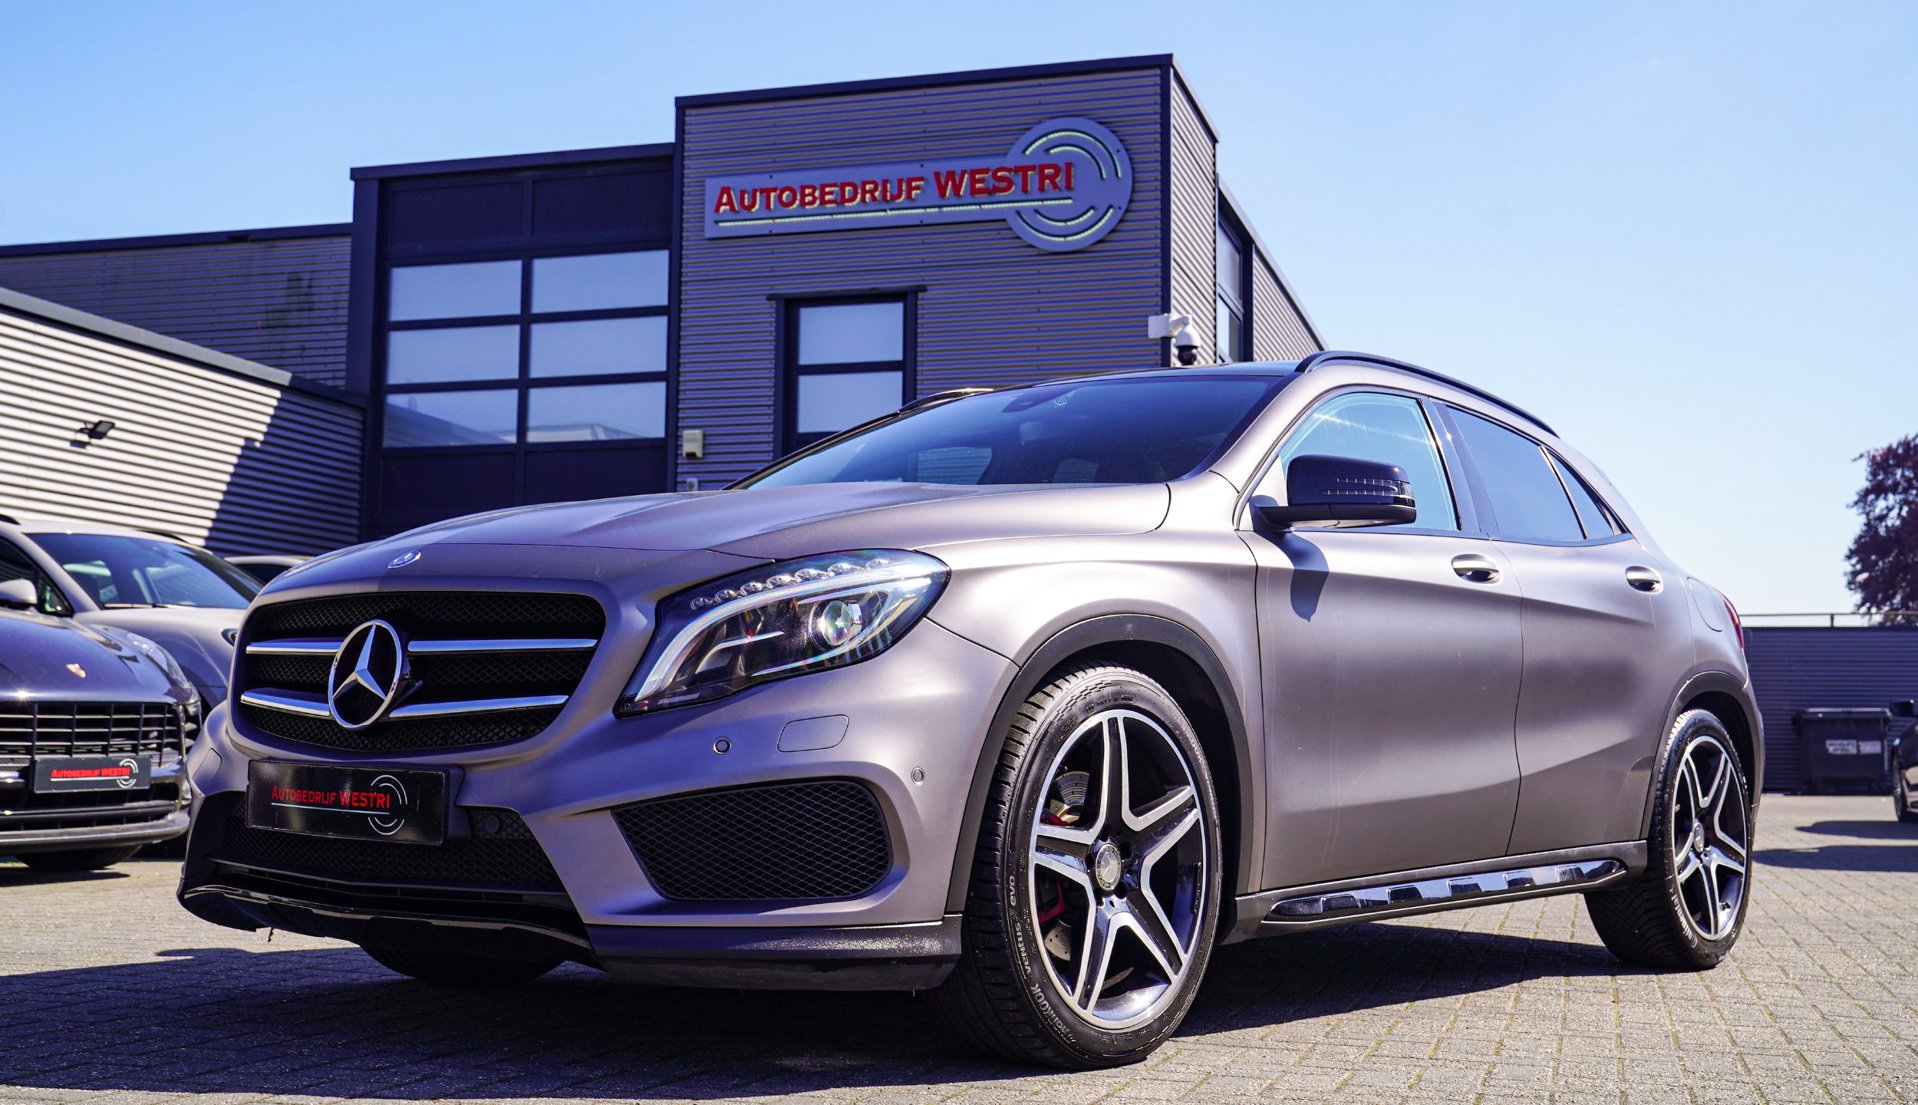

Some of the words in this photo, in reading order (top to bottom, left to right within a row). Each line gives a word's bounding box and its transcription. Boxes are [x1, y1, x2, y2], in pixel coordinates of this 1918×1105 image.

[714, 176, 925, 213] AUTOBEDRIJF
[934, 161, 1074, 199] WESTRI
[101, 767, 131, 777] WESTRI
[271, 785, 337, 806] AUTOBEDRIJF
[339, 790, 391, 809] WESTRI
